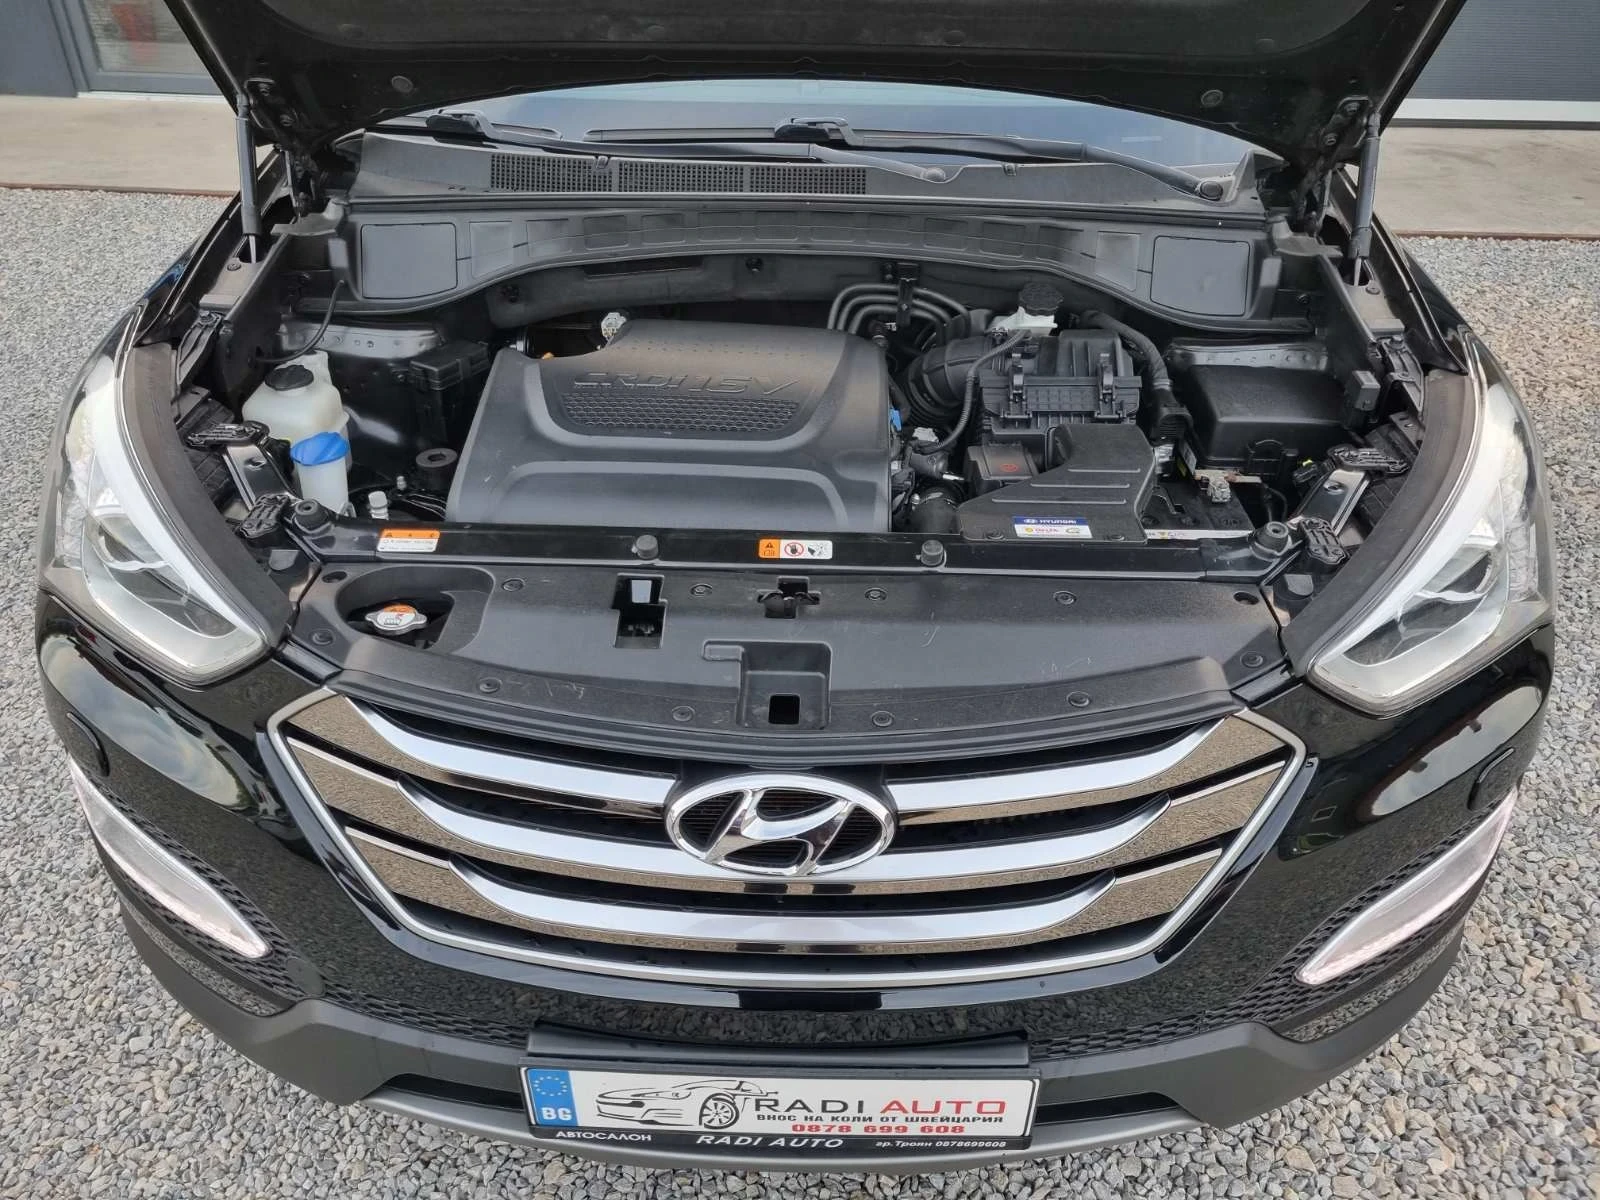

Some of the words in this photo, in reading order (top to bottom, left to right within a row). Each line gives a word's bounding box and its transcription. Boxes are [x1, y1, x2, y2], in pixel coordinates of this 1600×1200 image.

[755, 1098, 864, 1114] RADI
[880, 1100, 1006, 1115] AUTO
[541, 1107, 572, 1121] BG
[756, 1114, 796, 1122] ВНОС
[831, 1115, 873, 1123] КОЛИ
[905, 1115, 1003, 1123] ШВЕЙЦАРИЯ
[792, 1124, 851, 1133] 0878
[864, 1125, 908, 1134] 699
[920, 1125, 964, 1134] 608
[556, 1130, 652, 1141] АВТОСАЛОН
[696, 1135, 763, 1146] RADI
[768, 1136, 844, 1148] AUTO
